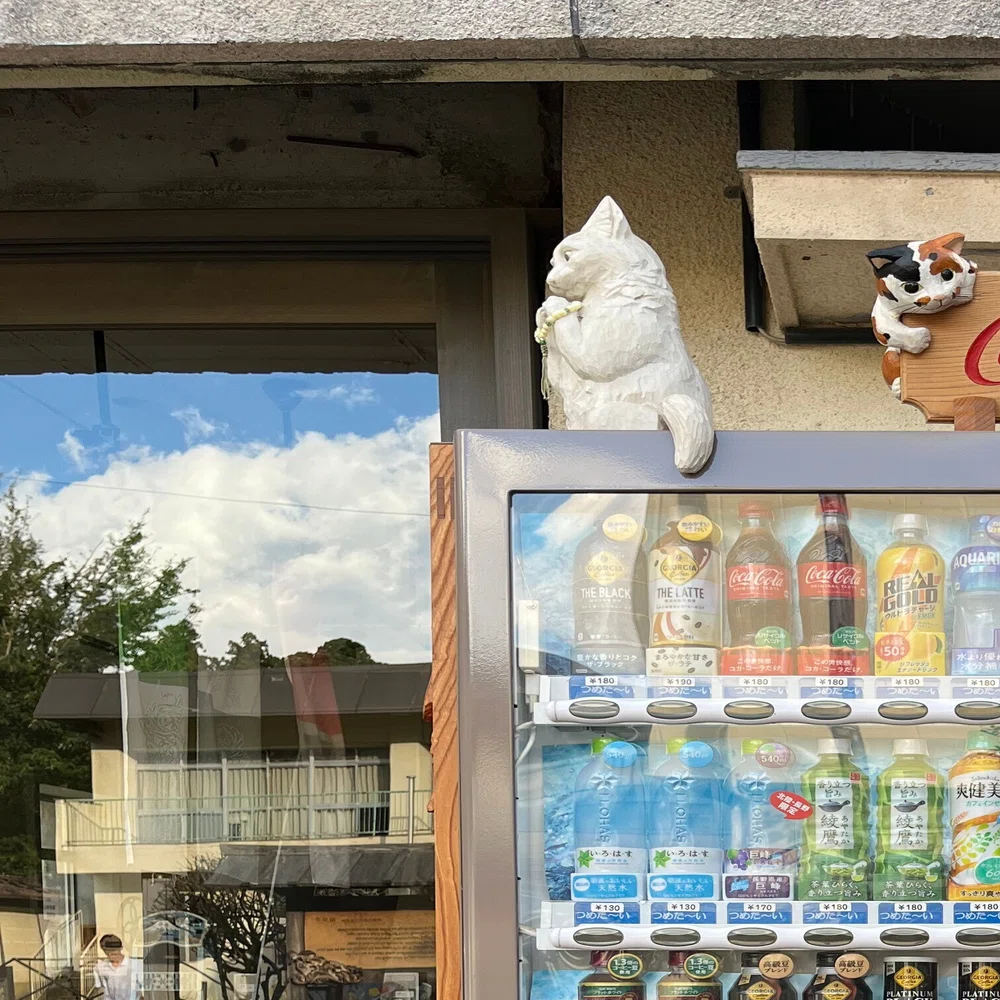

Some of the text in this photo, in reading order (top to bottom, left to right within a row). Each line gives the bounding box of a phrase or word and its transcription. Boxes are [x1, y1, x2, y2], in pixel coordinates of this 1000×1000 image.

[729, 568, 785, 587] Coca-Cola
[805, 565, 863, 585] Coca-Cola
[883, 569, 938, 598] REAL
[581, 588, 632, 600] THE BLACK
[657, 588, 705, 600] THE LATTE
[883, 588, 938, 613] GOLD
[820, 814, 840, 845] 綾鷹
[895, 814, 915, 845] 綾鷹
[808, 890, 862, 898] 香り立つ旨み
[883, 890, 937, 898] 香り立つ旨み
[762, 960, 789, 968] 高級豆
[839, 960, 864, 968] 高級豆
[886, 990, 933, 998] PLATINUM
